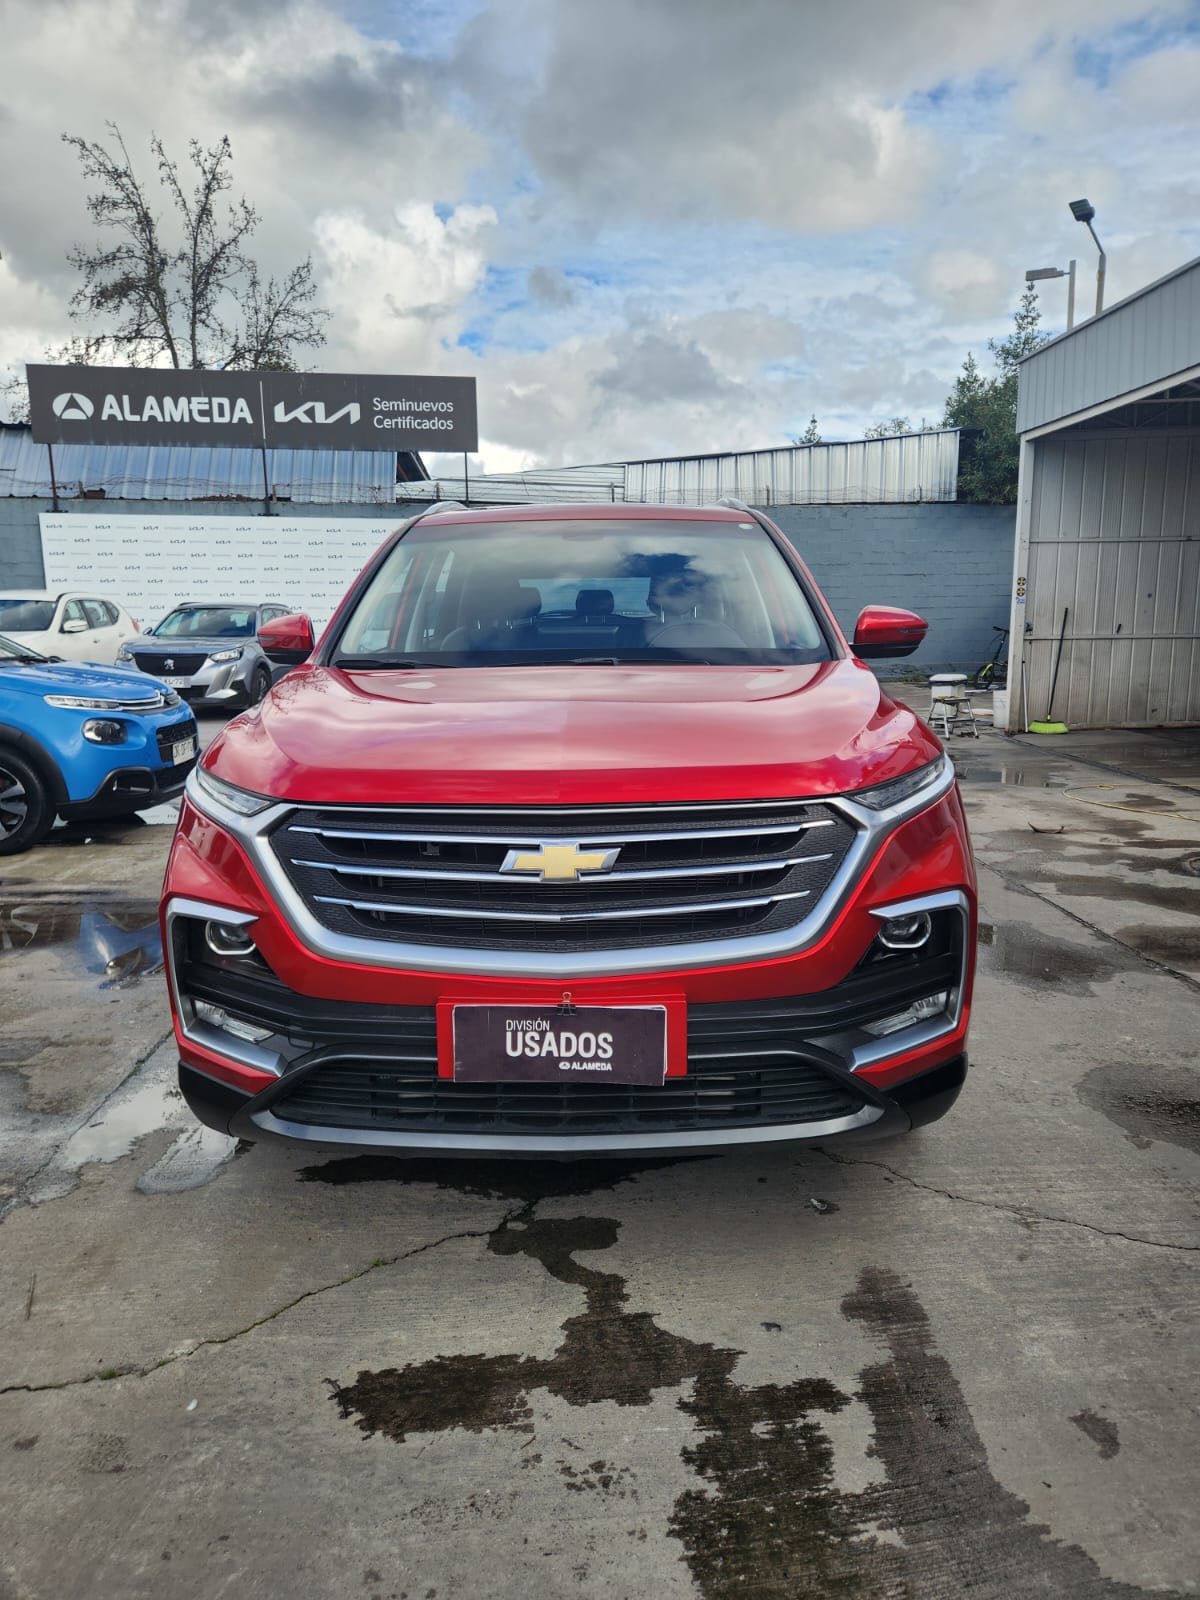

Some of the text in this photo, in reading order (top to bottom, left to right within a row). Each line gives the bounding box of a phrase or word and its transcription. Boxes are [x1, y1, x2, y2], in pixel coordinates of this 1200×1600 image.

[101, 394, 253, 424] ALAMEDA
[372, 397, 454, 412] Seminuevos
[274, 401, 361, 424] KIA
[373, 415, 454, 430] Certificados
[506, 1017, 550, 1031] DIVISIÓN
[506, 1031, 613, 1058] USADOS
[571, 1062, 612, 1071] ALAMEDA
